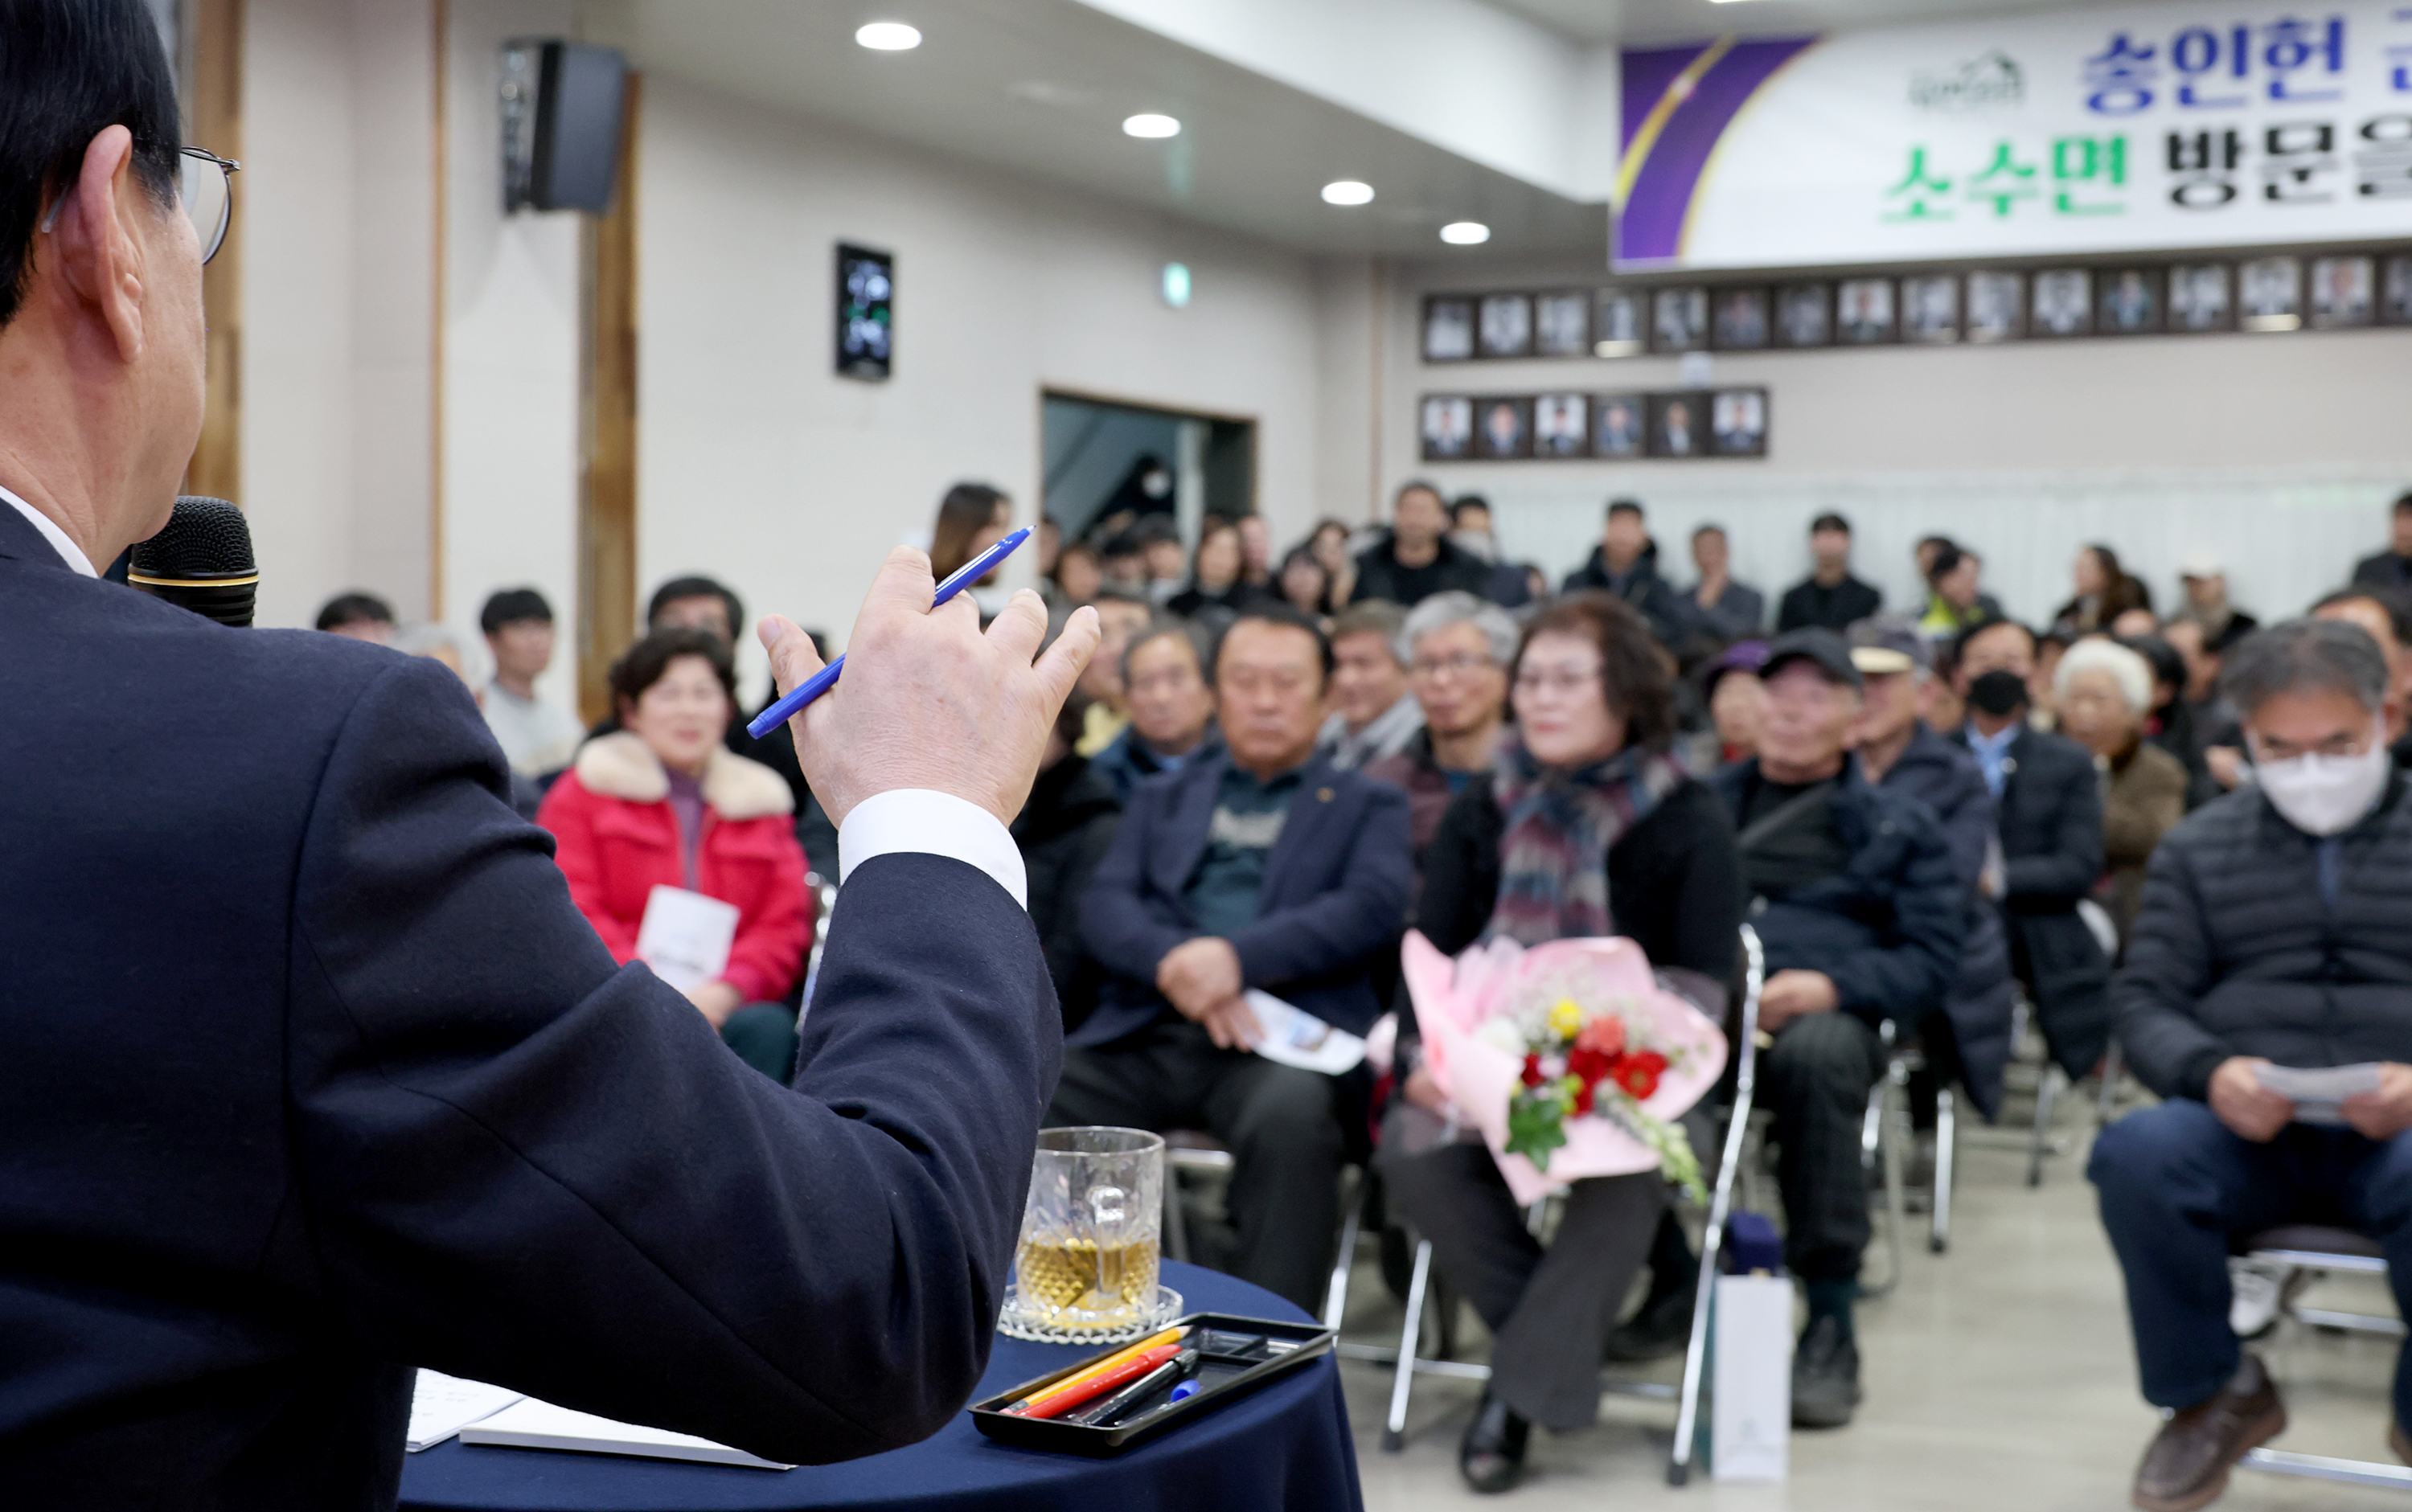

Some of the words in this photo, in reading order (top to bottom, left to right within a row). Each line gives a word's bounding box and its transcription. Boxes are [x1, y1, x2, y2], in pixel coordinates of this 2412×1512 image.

[2080, 14, 2345, 115] 송인헌
[1880, 134, 2128, 223] 소수면
[2167, 115, 2412, 210] 방문을
